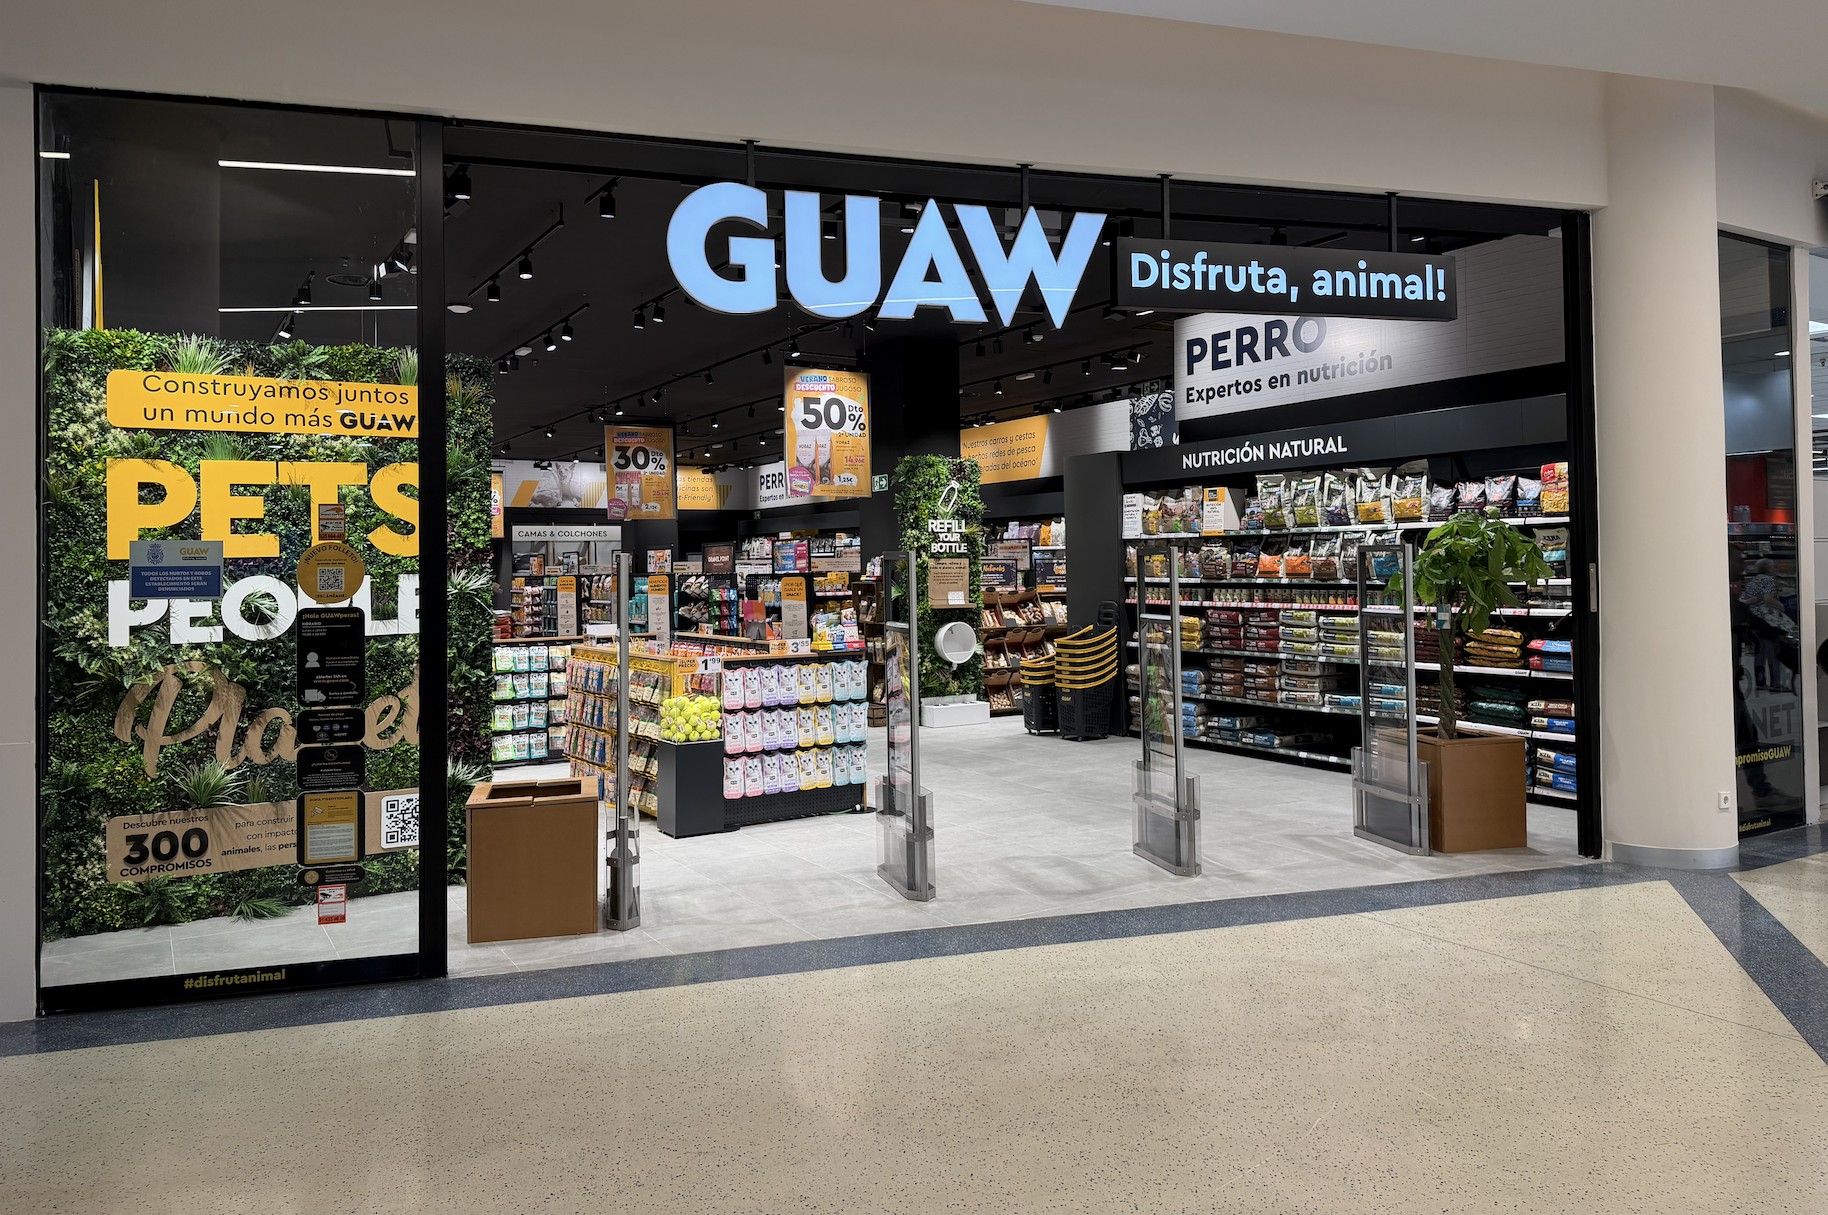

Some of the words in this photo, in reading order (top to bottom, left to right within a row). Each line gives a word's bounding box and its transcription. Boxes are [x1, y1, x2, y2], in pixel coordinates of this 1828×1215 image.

[666, 181, 1107, 329] GUAW
[1130, 250, 1298, 302] Disfruta,
[1313, 260, 1446, 301] animal!
[1186, 316, 1327, 375] PERRO
[1186, 377, 1262, 404] Expertos
[1269, 372, 1291, 388] en
[1297, 351, 1392, 384] nutrición
[143, 374, 328, 401] Construyamos
[336, 383, 408, 405] juntos
[143, 407, 173, 421] un
[186, 406, 275, 425] mundo
[285, 408, 332, 428] más
[340, 412, 416, 431] GUAW
[801, 397, 846, 430] 50
[848, 405, 864, 413] Dto
[848, 414, 866, 431] %
[989, 437, 1008, 445] carros
[1009, 436, 1013, 444] y
[1015, 431, 1036, 441] cestas
[614, 446, 650, 470] 30
[989, 449, 1006, 458] redes
[1008, 446, 1015, 456] de
[1017, 445, 1036, 456] pesca
[1182, 441, 1264, 470] NUTRICIÓN
[1268, 436, 1347, 461] NATURAL
[651, 457, 666, 471] %
[1001, 461, 1011, 470] del
[759, 472, 784, 491] PERR
[759, 494, 778, 503] Expertos
[106, 458, 419, 559] PETS
[928, 519, 966, 532] REFILL
[938, 533, 960, 542] YOUR
[180, 547, 210, 555] GUAW
[304, 545, 327, 564] ¡NUEVO
[329, 544, 359, 564] FOLLETO!
[931, 543, 968, 553] BOTTLE
[114, 661, 419, 778] Plaet
[1735, 745, 1792, 767] promisoGUAW
[123, 819, 167, 830] Descubre
[170, 815, 209, 826] nuestros
[235, 820, 255, 830] para
[256, 815, 295, 826] construir
[246, 832, 263, 840] con
[123, 827, 209, 865] 300
[221, 845, 263, 856] animales,
[265, 843, 277, 851] las
[120, 858, 212, 877] COMPROMISOS
[184, 968, 285, 989] #disfrutanimal
